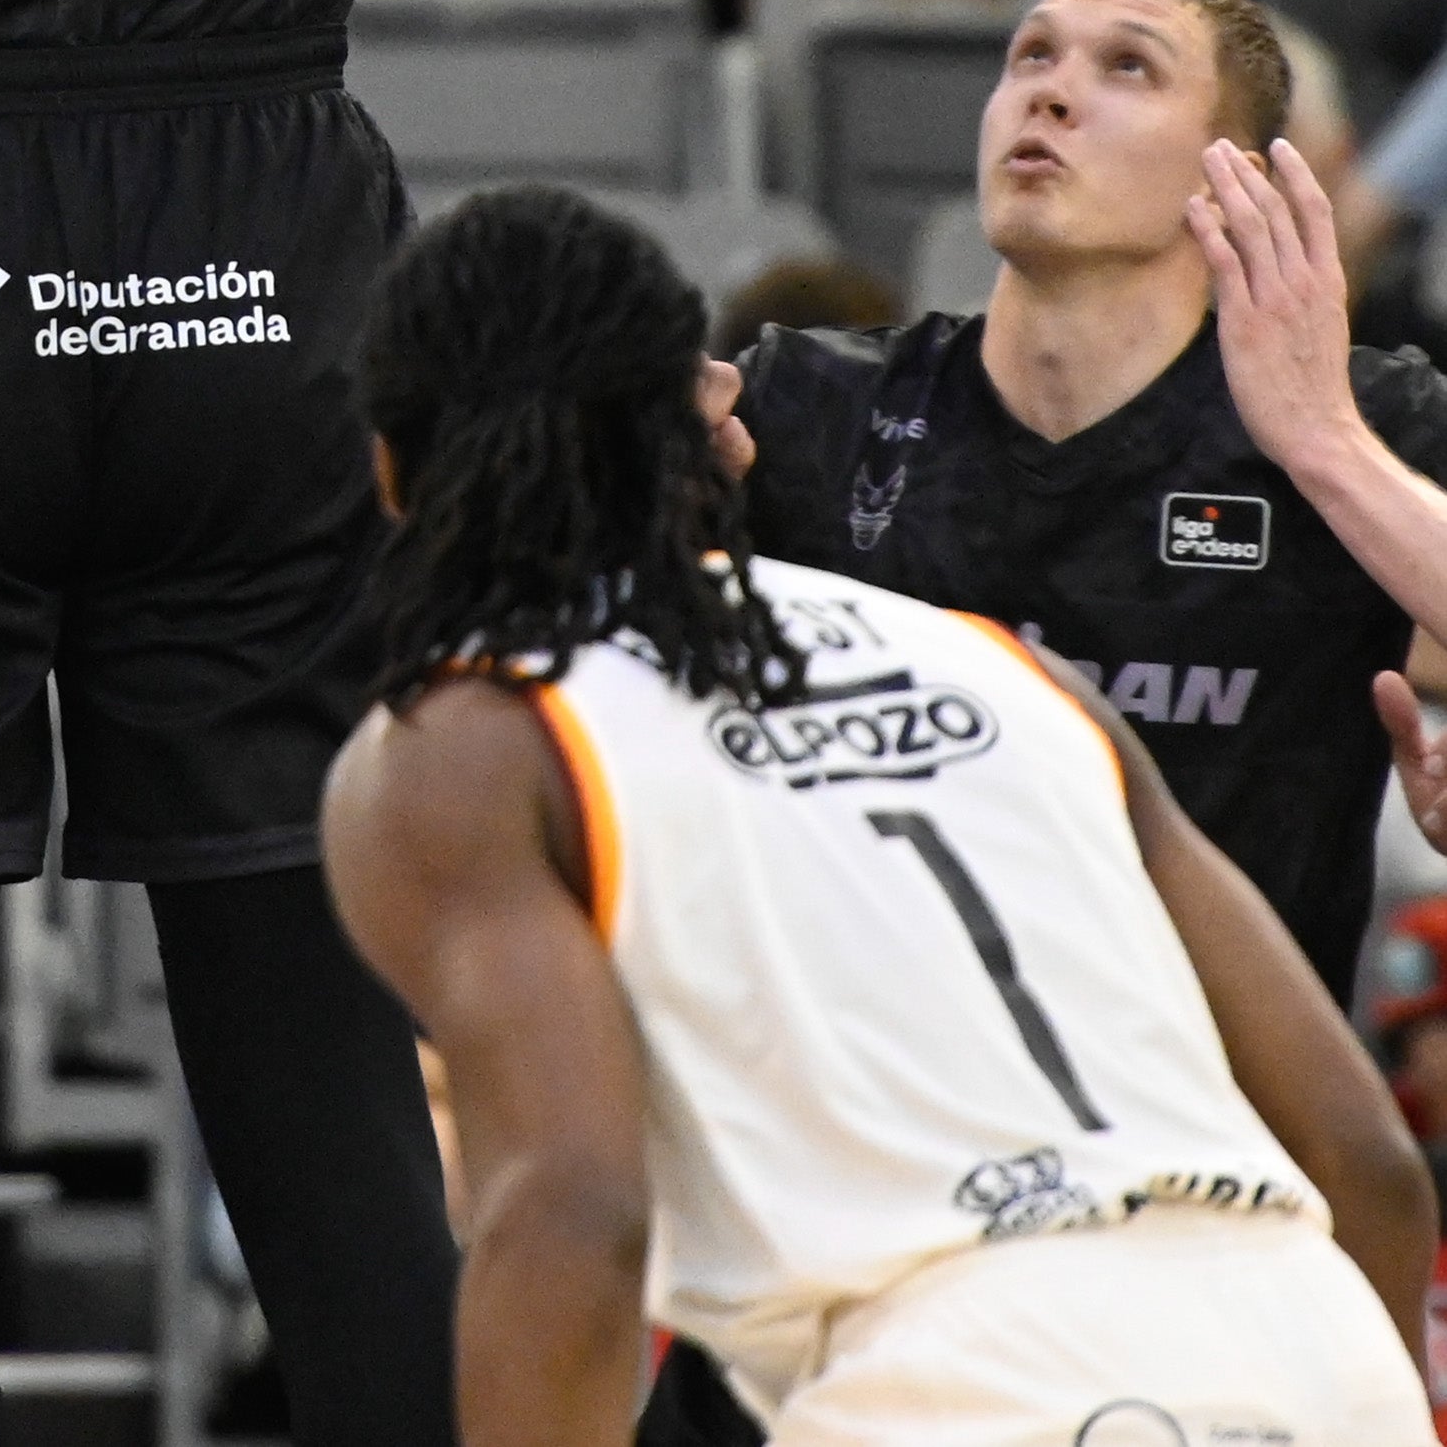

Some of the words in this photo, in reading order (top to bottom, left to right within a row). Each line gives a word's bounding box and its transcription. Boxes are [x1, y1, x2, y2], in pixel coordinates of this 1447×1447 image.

[28, 260, 276, 316] Diputación
[1171, 515, 1215, 539] liga
[1171, 537, 1260, 559] endesa
[865, 810, 1115, 1133] 1
